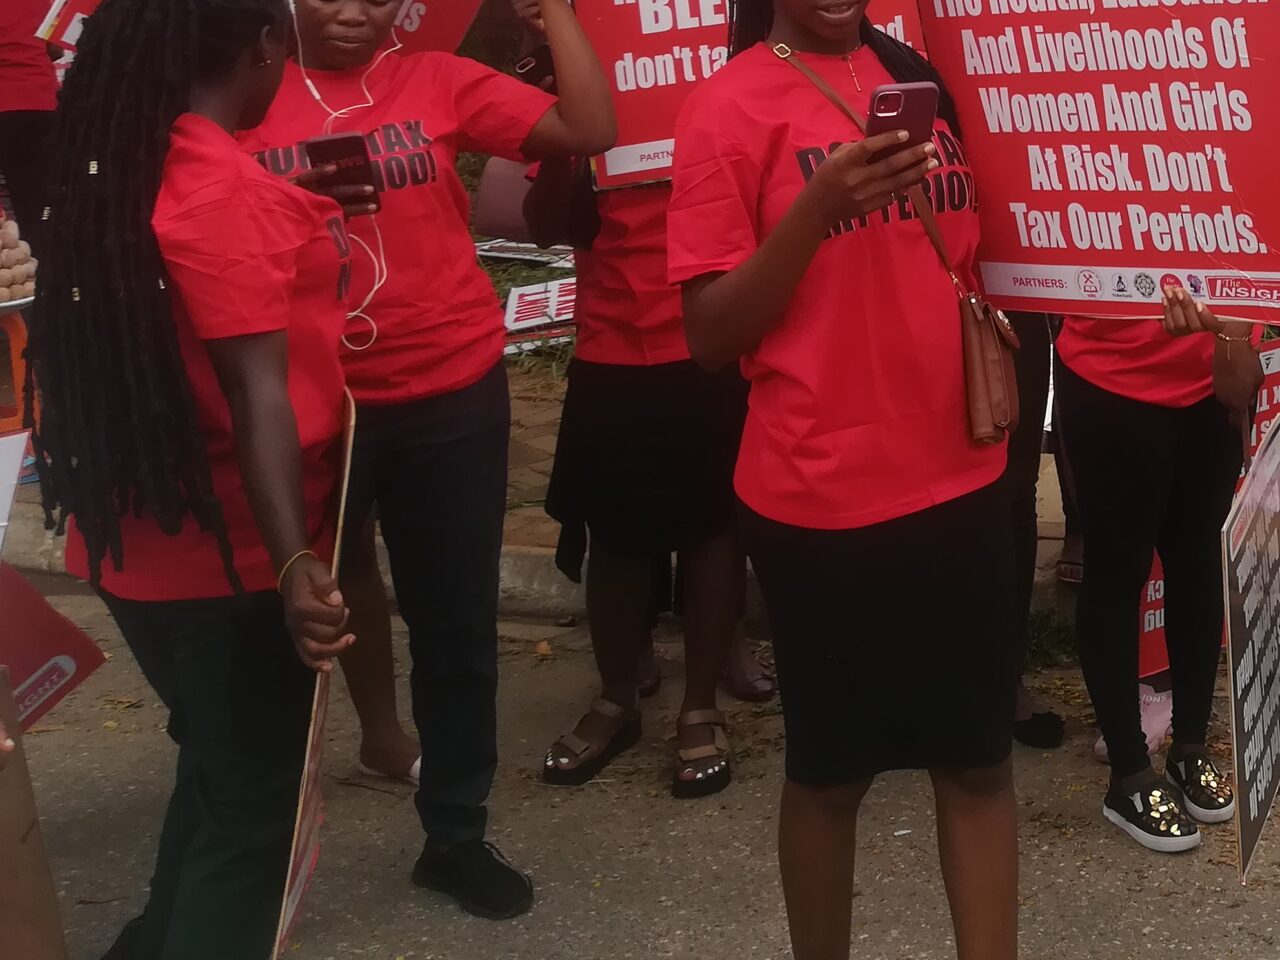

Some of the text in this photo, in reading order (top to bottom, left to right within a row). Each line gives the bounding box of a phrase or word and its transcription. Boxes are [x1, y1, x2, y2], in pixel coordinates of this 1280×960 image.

[614, 44, 729, 92] don't ta
[961, 26, 1020, 76] And
[1022, 19, 1204, 74] Livelihoods
[1212, 17, 1251, 68] Of
[978, 81, 1253, 134] Women And Girls
[639, 150, 673, 163] PARTN
[1027, 145, 1063, 192] At
[1063, 143, 1143, 192] Risk.
[1143, 143, 1234, 193] Don't
[1009, 202, 1268, 254] Tax Our Periods.
[1012, 276, 1068, 289] PARTNERS:
